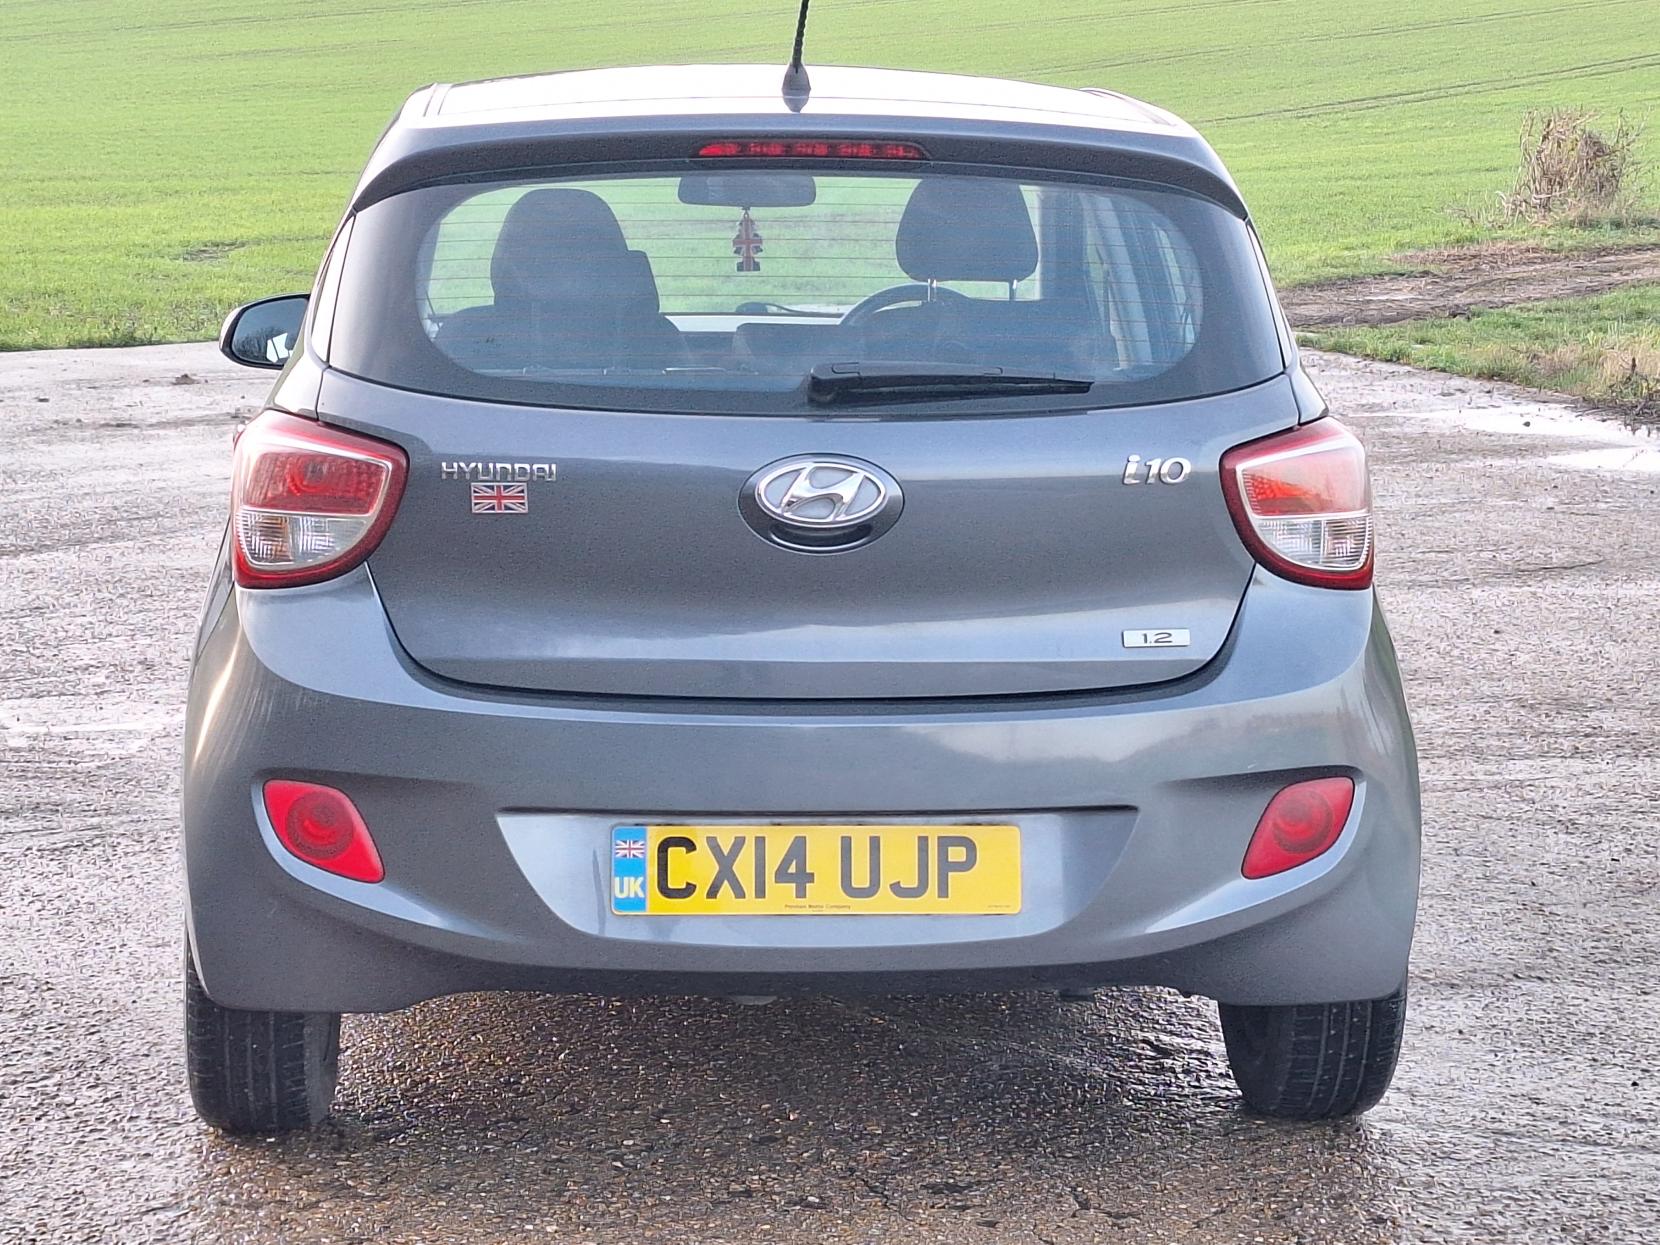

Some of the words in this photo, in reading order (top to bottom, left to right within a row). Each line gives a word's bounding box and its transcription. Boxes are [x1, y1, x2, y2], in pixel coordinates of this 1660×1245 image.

[441, 461, 557, 481] HYUNDAI
[1123, 454, 1192, 485] i10
[1141, 631, 1174, 645] 1.2
[656, 835, 815, 899] CX14
[840, 835, 978, 899] UJP
[614, 876, 645, 898] UK
